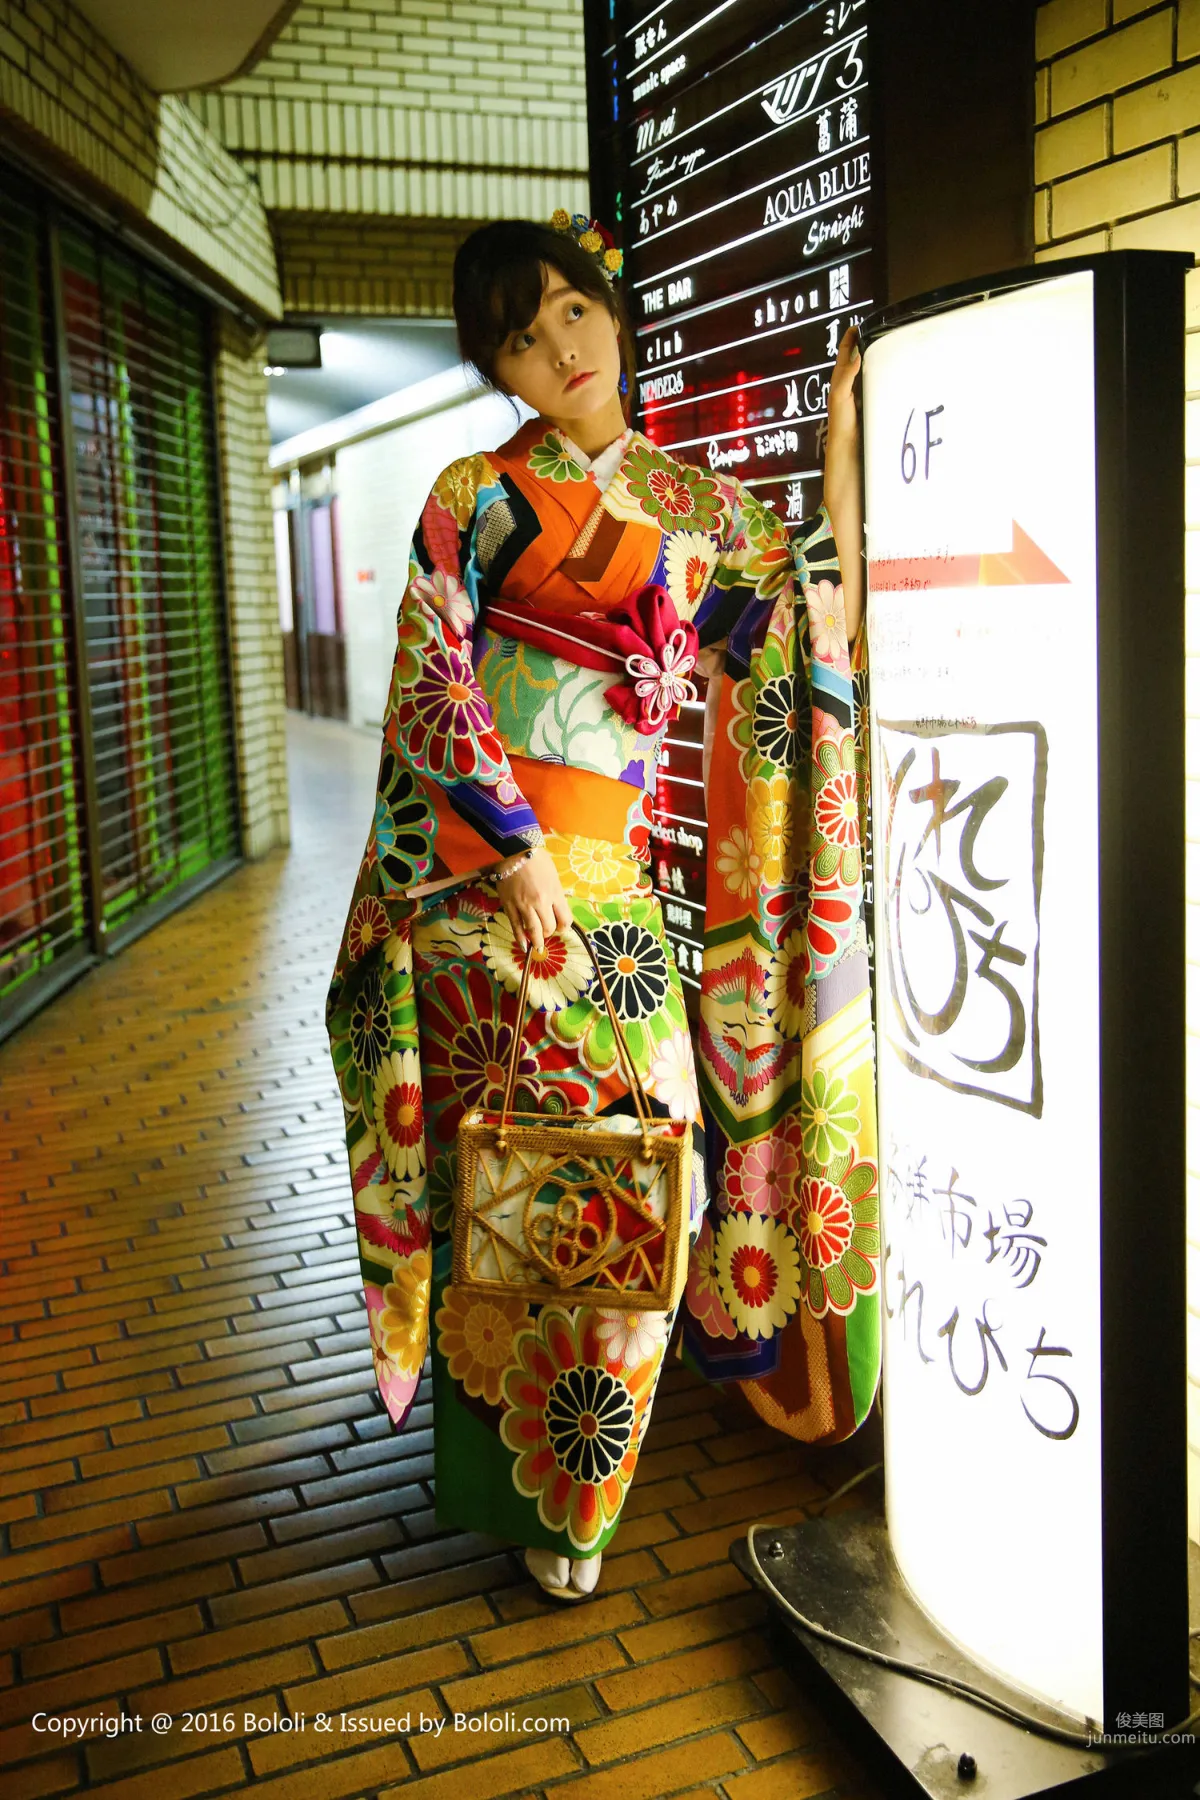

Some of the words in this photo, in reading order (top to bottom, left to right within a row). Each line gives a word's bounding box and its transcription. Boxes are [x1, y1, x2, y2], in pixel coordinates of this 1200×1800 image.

[763, 179, 816, 222] AQUA
[819, 152, 871, 202] BLUE
[803, 205, 864, 255] Straight
[642, 287, 664, 314] THE
[667, 277, 691, 306] BAR
[647, 331, 682, 362] club
[640, 370, 684, 404] MEMBERS
[901, 404, 945, 484] 6F
